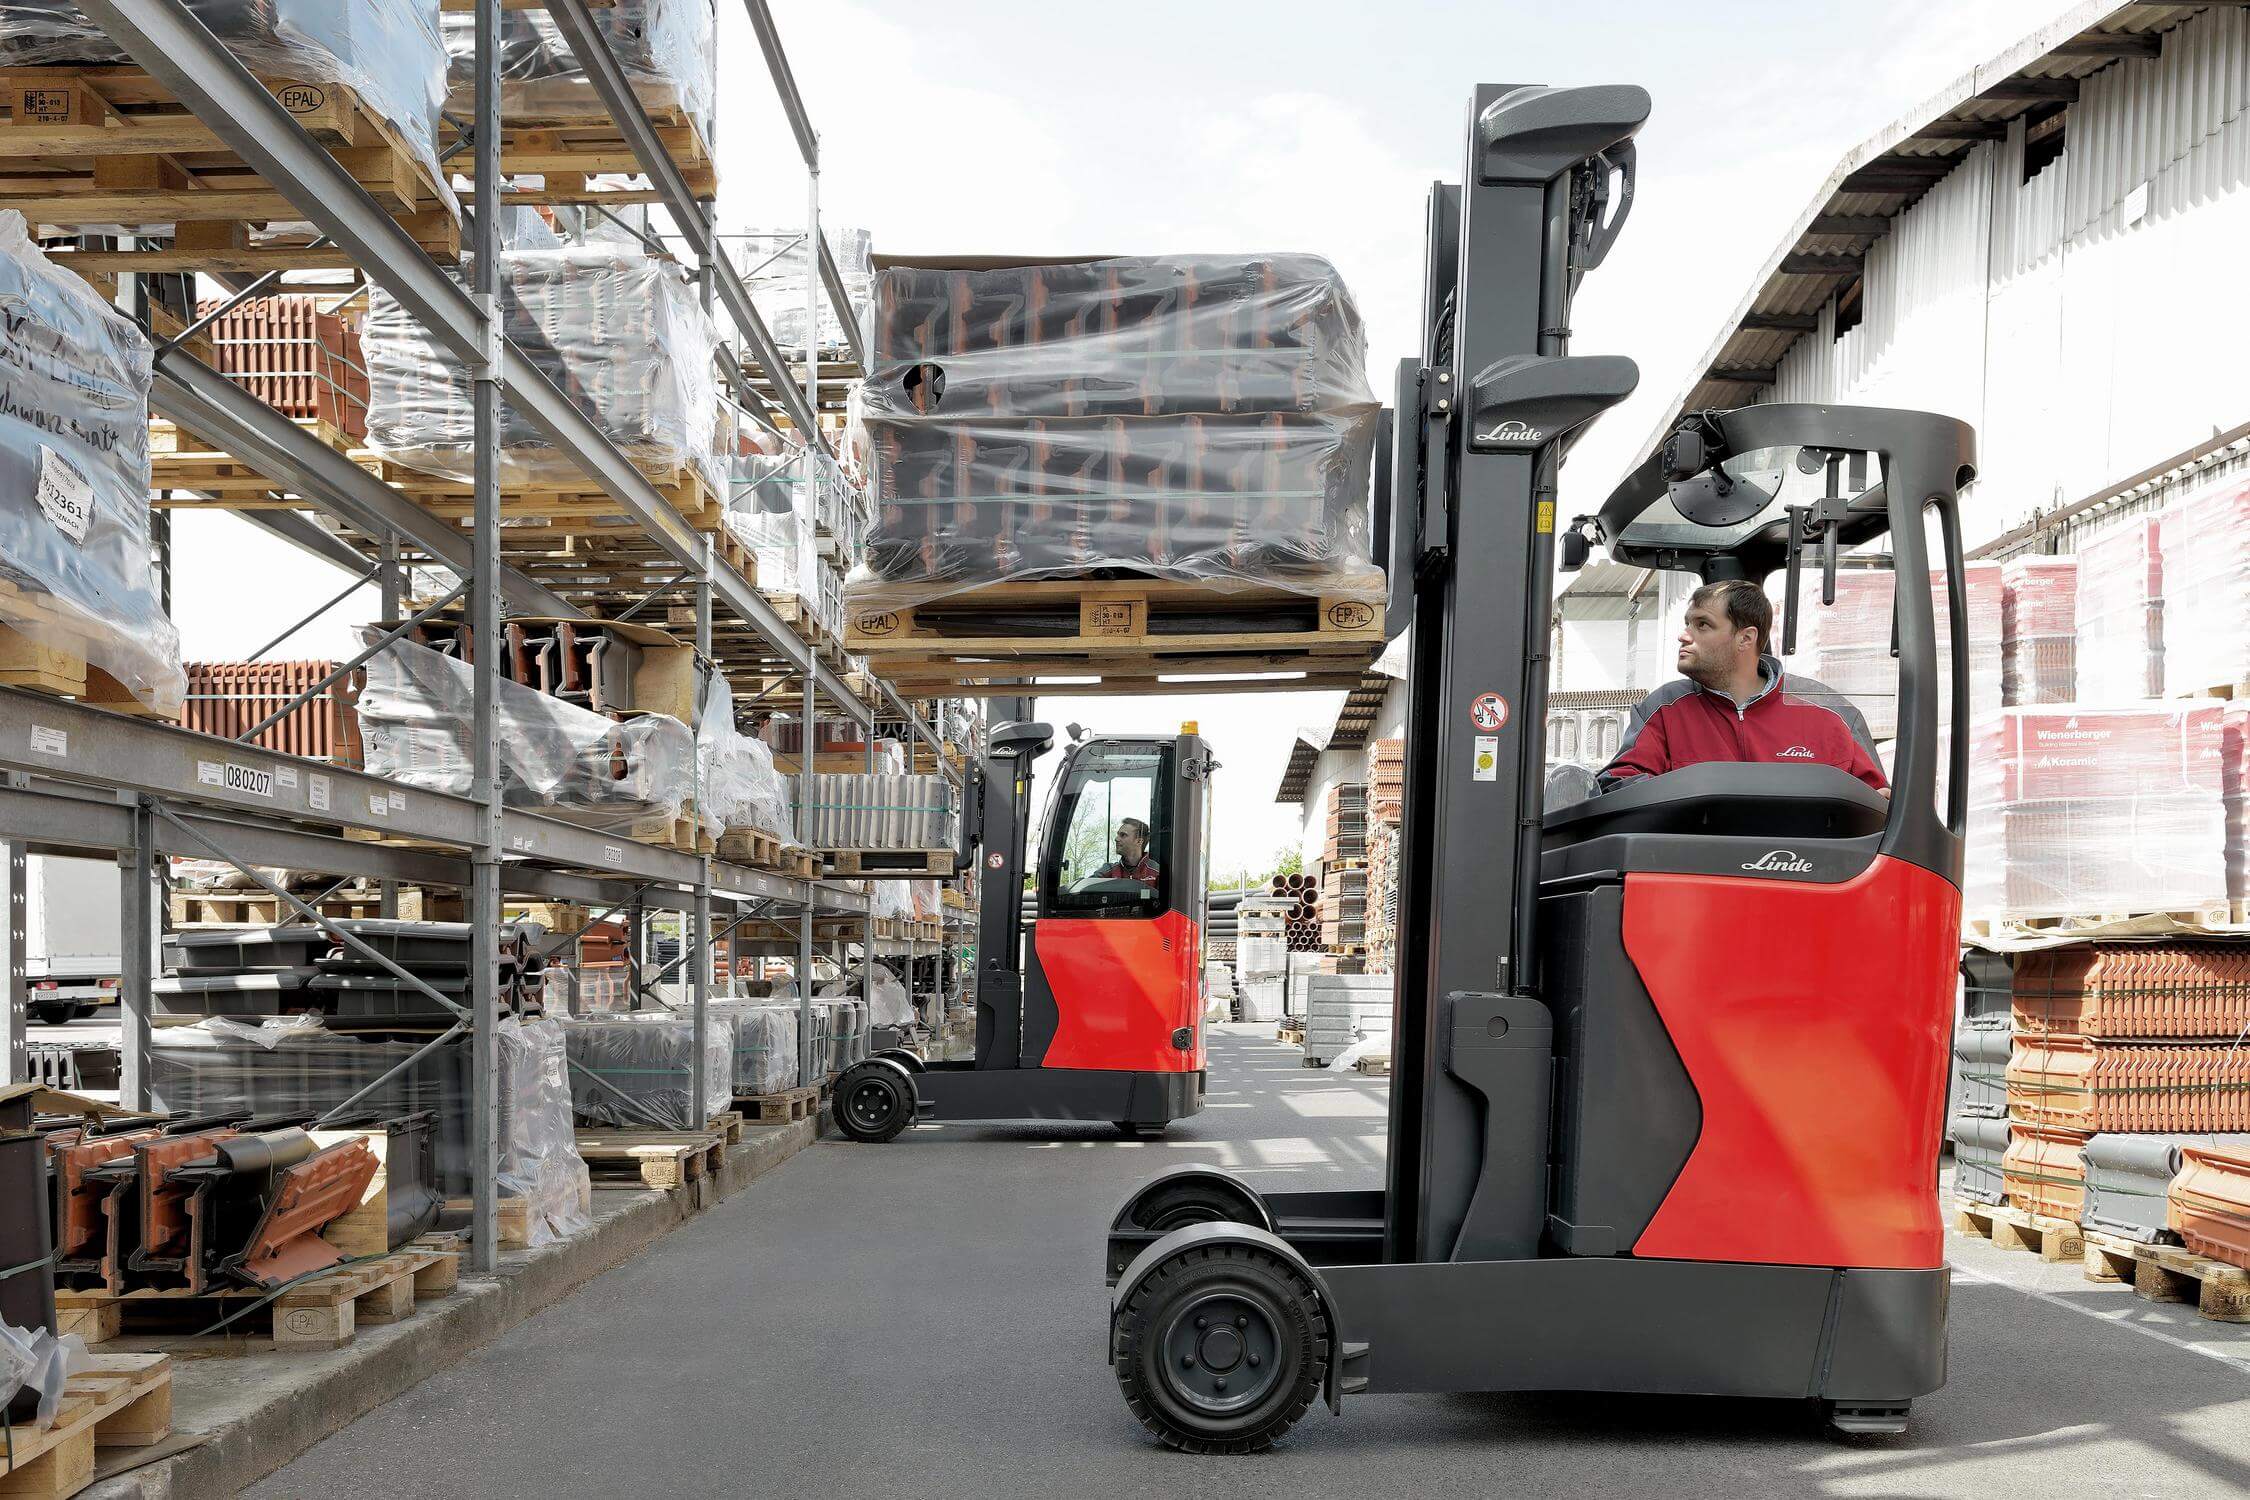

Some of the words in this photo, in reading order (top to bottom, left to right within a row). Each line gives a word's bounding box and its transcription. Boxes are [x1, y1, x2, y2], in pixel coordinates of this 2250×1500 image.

[284, 91, 318, 107] EPAL
[1476, 420, 1542, 441] Linde
[861, 614, 893, 630] EPAL
[1336, 607, 1368, 623] EPAL
[2037, 729, 2113, 741] Wienerberger
[1776, 745, 1816, 759] Linde
[2051, 754, 2097, 767] Koramic
[227, 765, 270, 794] 080207
[1741, 849, 1813, 873] Linde
[2064, 1241, 2085, 1252] EPAL
